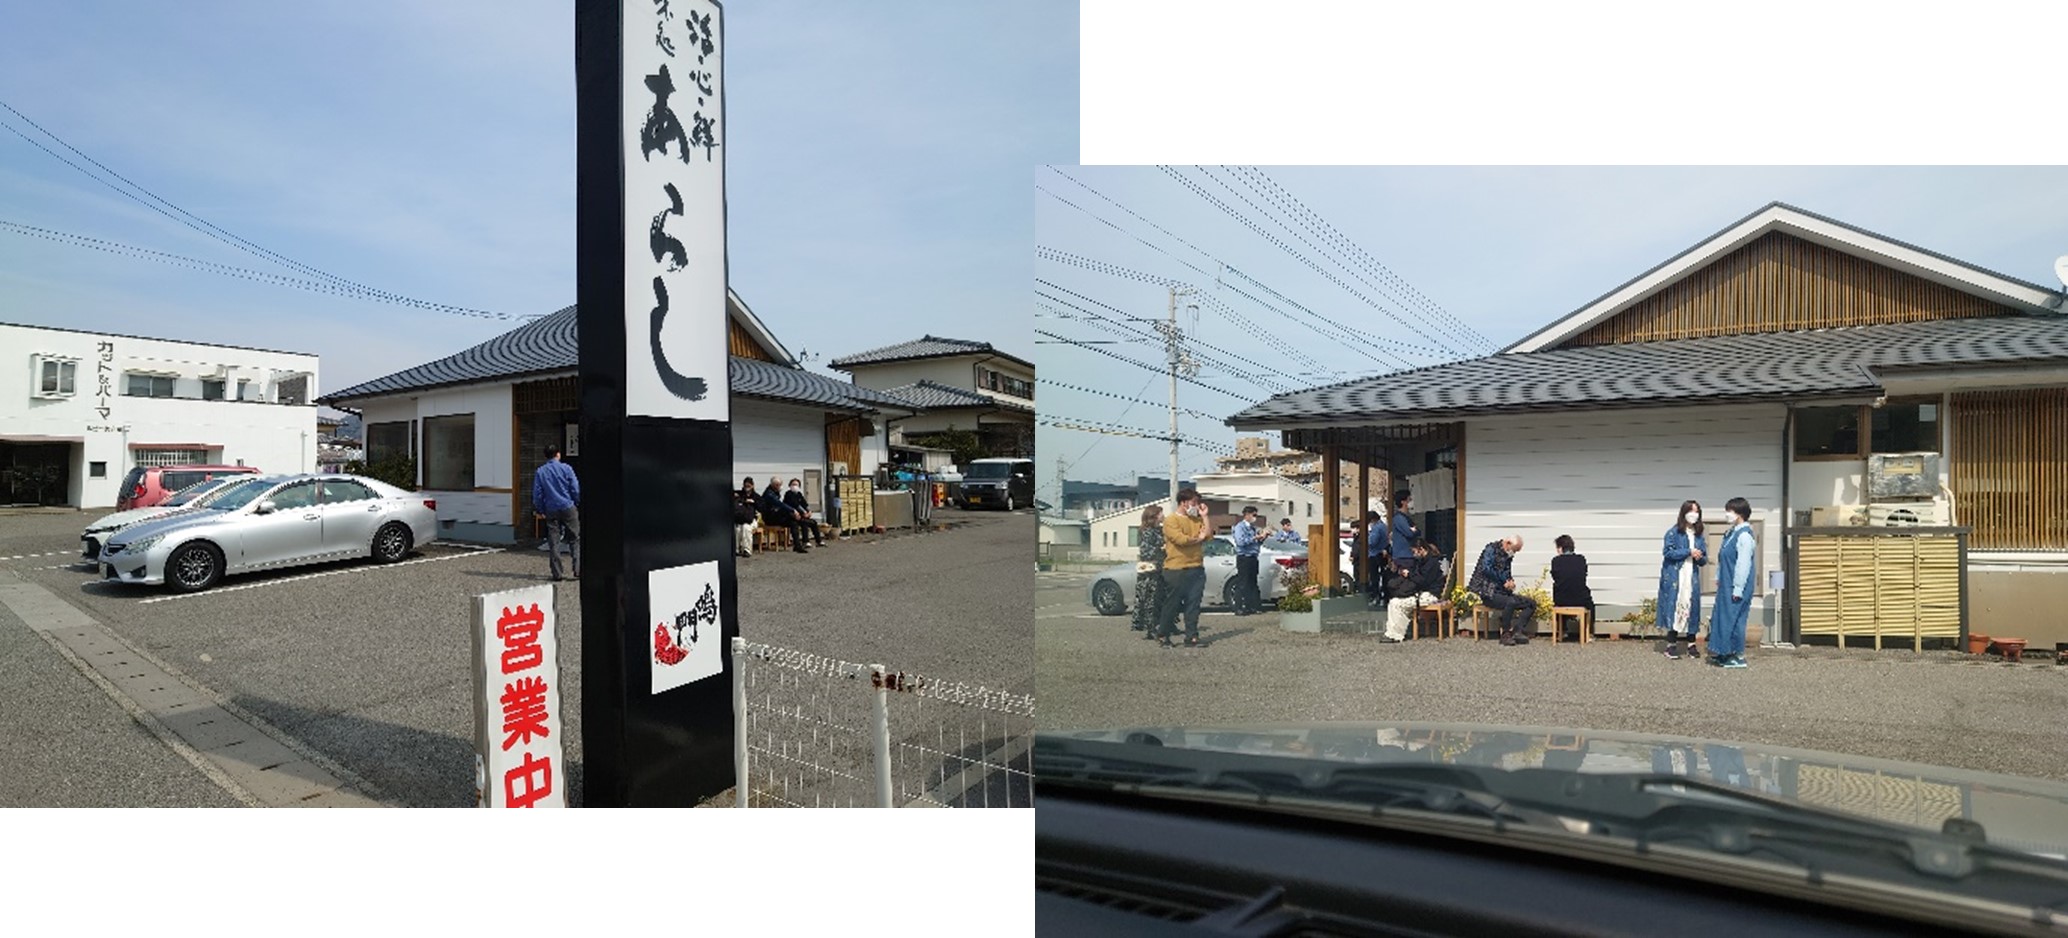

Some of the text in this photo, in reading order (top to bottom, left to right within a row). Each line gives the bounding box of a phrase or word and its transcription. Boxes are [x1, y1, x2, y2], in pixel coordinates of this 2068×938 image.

[641, 64, 708, 401] あらし
[497, 603, 552, 808] 営業中
